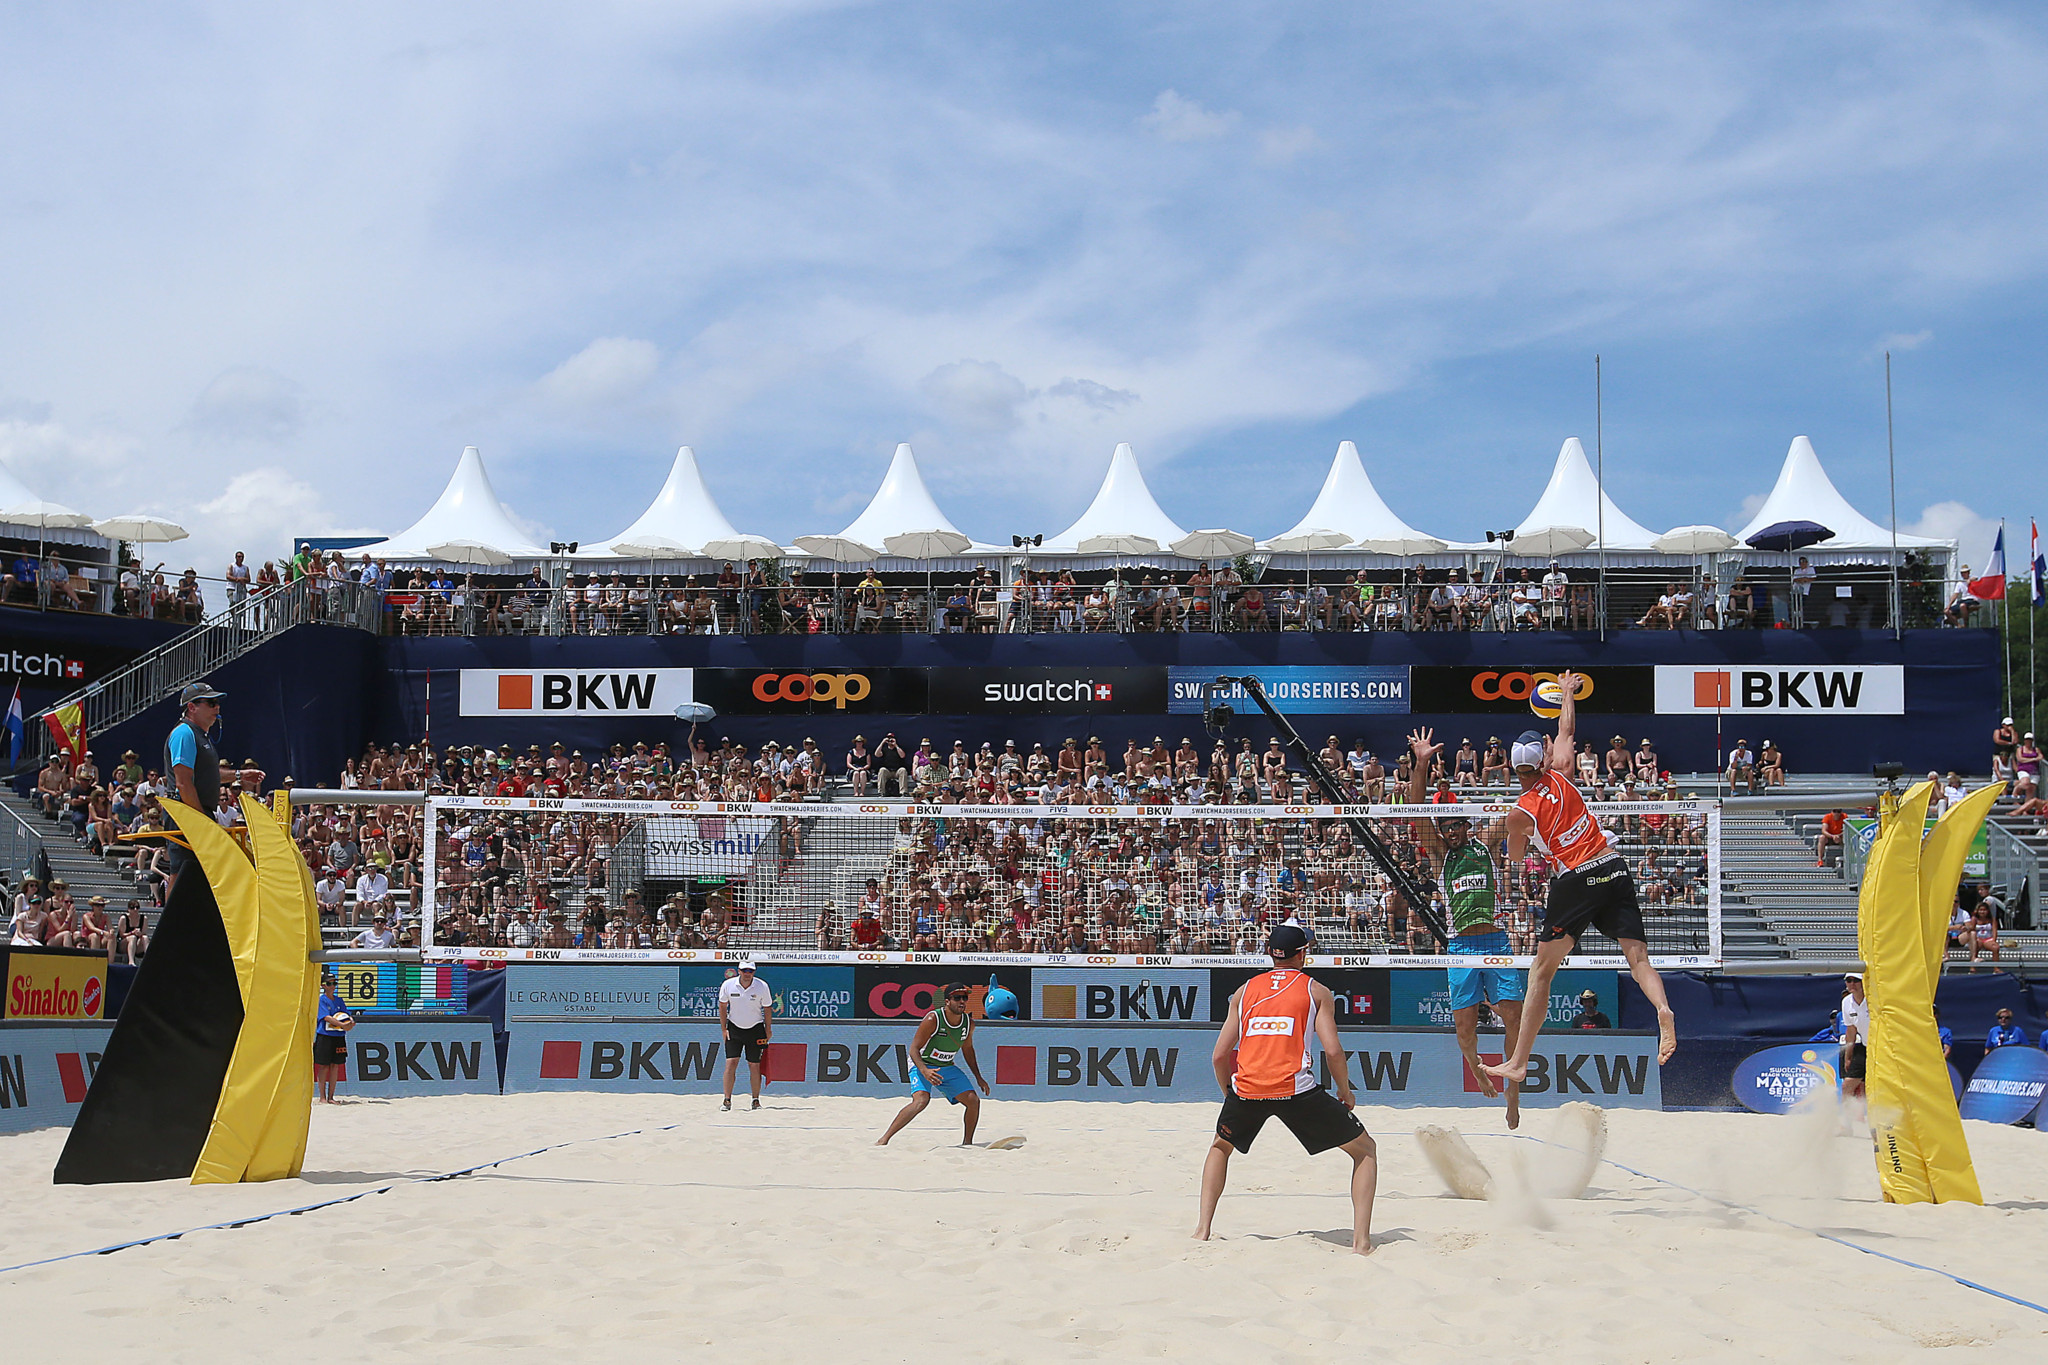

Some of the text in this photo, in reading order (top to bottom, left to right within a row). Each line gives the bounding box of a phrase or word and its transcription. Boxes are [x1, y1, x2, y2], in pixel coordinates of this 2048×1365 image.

[542, 673, 657, 710] BKW
[752, 672, 871, 710] coop
[984, 678, 1092, 702] swatch
[1174, 682, 1402, 699] SWCHJORSERIES.COM
[1741, 671, 1863, 708] BKW
[482, 798, 512, 808] coop
[1546, 794, 1558, 804] 2
[538, 800, 564, 809] BKW
[581, 802, 653, 810] SWATCHMAJORSERIES.COM
[670, 802, 699, 812] coop
[727, 804, 752, 813] BKW
[860, 805, 889, 814] coop
[1483, 805, 1512, 814] coop
[916, 806, 942, 814] BKW
[1088, 807, 1118, 816] coop
[1146, 806, 1173, 816] BKW
[1284, 806, 1314, 816] coop
[1344, 806, 1370, 815] BKW
[650, 834, 760, 855] swissmill
[1575, 861, 1598, 873] UNDER
[1461, 879, 1484, 887] BKW
[479, 949, 508, 958] coop
[535, 950, 561, 960] BKW
[668, 950, 696, 960] coop
[724, 951, 750, 960] BKW
[858, 953, 887, 962] coop
[915, 954, 941, 963] BKW
[1087, 956, 1116, 965] coop
[1146, 956, 1172, 965] BKW
[1344, 957, 1370, 966] BKW
[1483, 957, 1513, 966] coop
[344, 972, 374, 999] 18
[1270, 981, 1279, 990] 1
[10, 975, 78, 1016] Sinalco
[510, 991, 650, 1003] LE GRAND BELLEVUE
[790, 991, 850, 1004] GSTAAD
[681, 997, 720, 1009] MAJ
[1086, 985, 1198, 1020] BKW
[790, 1005, 838, 1017] MAJOR
[1418, 1002, 1452, 1014] MAJ
[1251, 1020, 1288, 1032] coop
[356, 1042, 482, 1081] BKW
[590, 1041, 720, 1080] BKW
[1048, 1047, 1179, 1087] BKW
[1320, 1051, 1412, 1091] KW
[1519, 1054, 1648, 1094] BKW
[1887, 1134, 1902, 1173] JINLING
